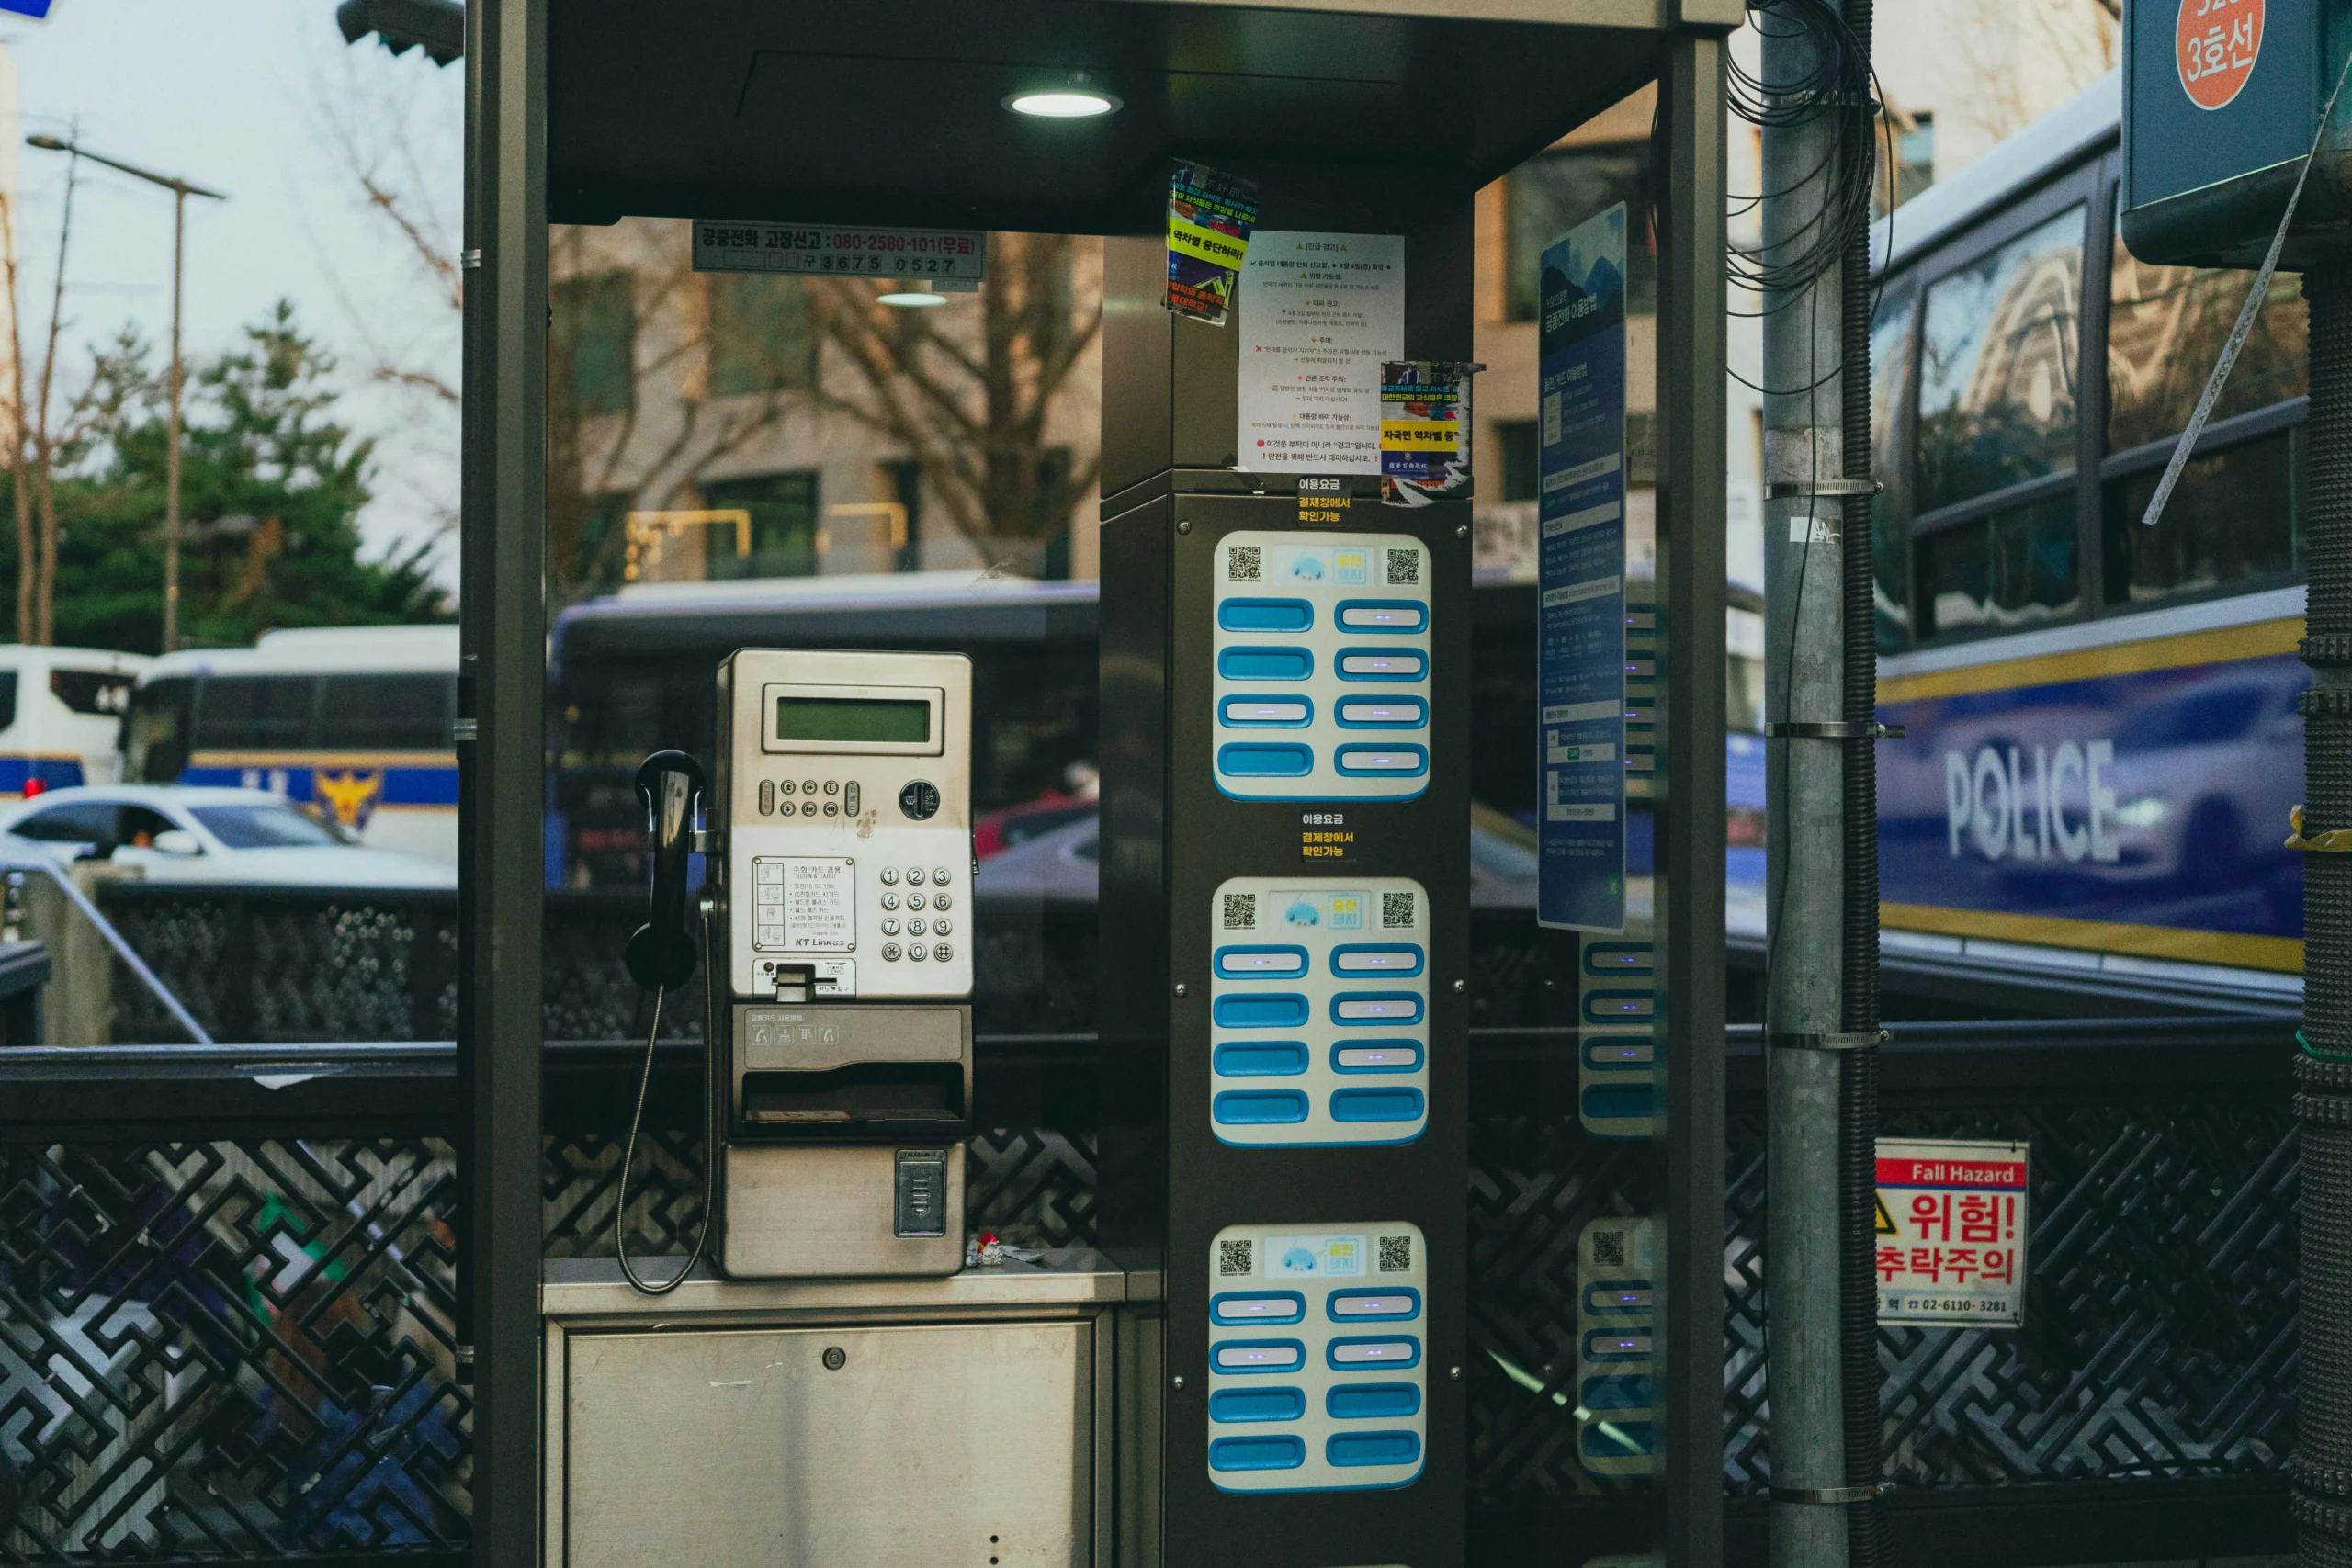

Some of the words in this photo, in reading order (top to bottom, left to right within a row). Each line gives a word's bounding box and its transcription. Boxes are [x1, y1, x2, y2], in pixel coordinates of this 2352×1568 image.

[2187, 12, 2253, 82] 3호선
[702, 228, 759, 248] 공중전화
[1173, 230, 1201, 247] 역차별
[1203, 239, 1244, 261] 중단하라!
[1306, 243, 1321, 252] [긴급
[1323, 243, 1339, 253] 경고]
[1309, 272, 1321, 280] 위험
[1319, 336, 1333, 344] 주의:
[1331, 375, 1346, 383] 주의:
[1381, 393, 1415, 401] 대한민국의
[1416, 393, 1443, 401] 자식들은
[1331, 413, 1351, 422] 가능성:
[1384, 430, 1411, 441] 자국민
[1414, 430, 1442, 441] 역차별
[1266, 439, 1286, 448] 이것은
[1289, 440, 1309, 448] 부탁이
[1311, 440, 1331, 449] 아니라
[1268, 453, 1288, 461] 안전을
[1291, 453, 1305, 461] 위해
[1306, 453, 1327, 461] 반드시
[1329, 454, 1371, 463] 대피하십시오.
[1298, 479, 1340, 491] 이용요금
[1298, 496, 1351, 508] 결제창에서
[1298, 510, 1340, 522] 확인가능
[1946, 738, 2120, 862] POLICE
[1302, 814, 1343, 825] 이용요금
[1302, 831, 1354, 843] 결제창에서
[1302, 846, 1344, 857] 확인가능
[888, 870, 892, 881] 1
[912, 870, 921, 882] 2
[938, 870, 946, 882] 3
[888, 896, 895, 907] 4
[913, 896, 921, 907] 5
[939, 896, 947, 907] 6
[888, 920, 895, 931] 7
[913, 920, 922, 932] 8
[939, 920, 947, 932] 9
[796, 938, 810, 946] KT
[913, 946, 922, 957] 0
[938, 946, 949, 956] #
[1912, 1164, 1945, 1181] Fall
[1950, 1165, 2014, 1183] Hazard
[1909, 1193, 2015, 1243] 위험!
[1876, 1246, 2014, 1285] 추락주의
